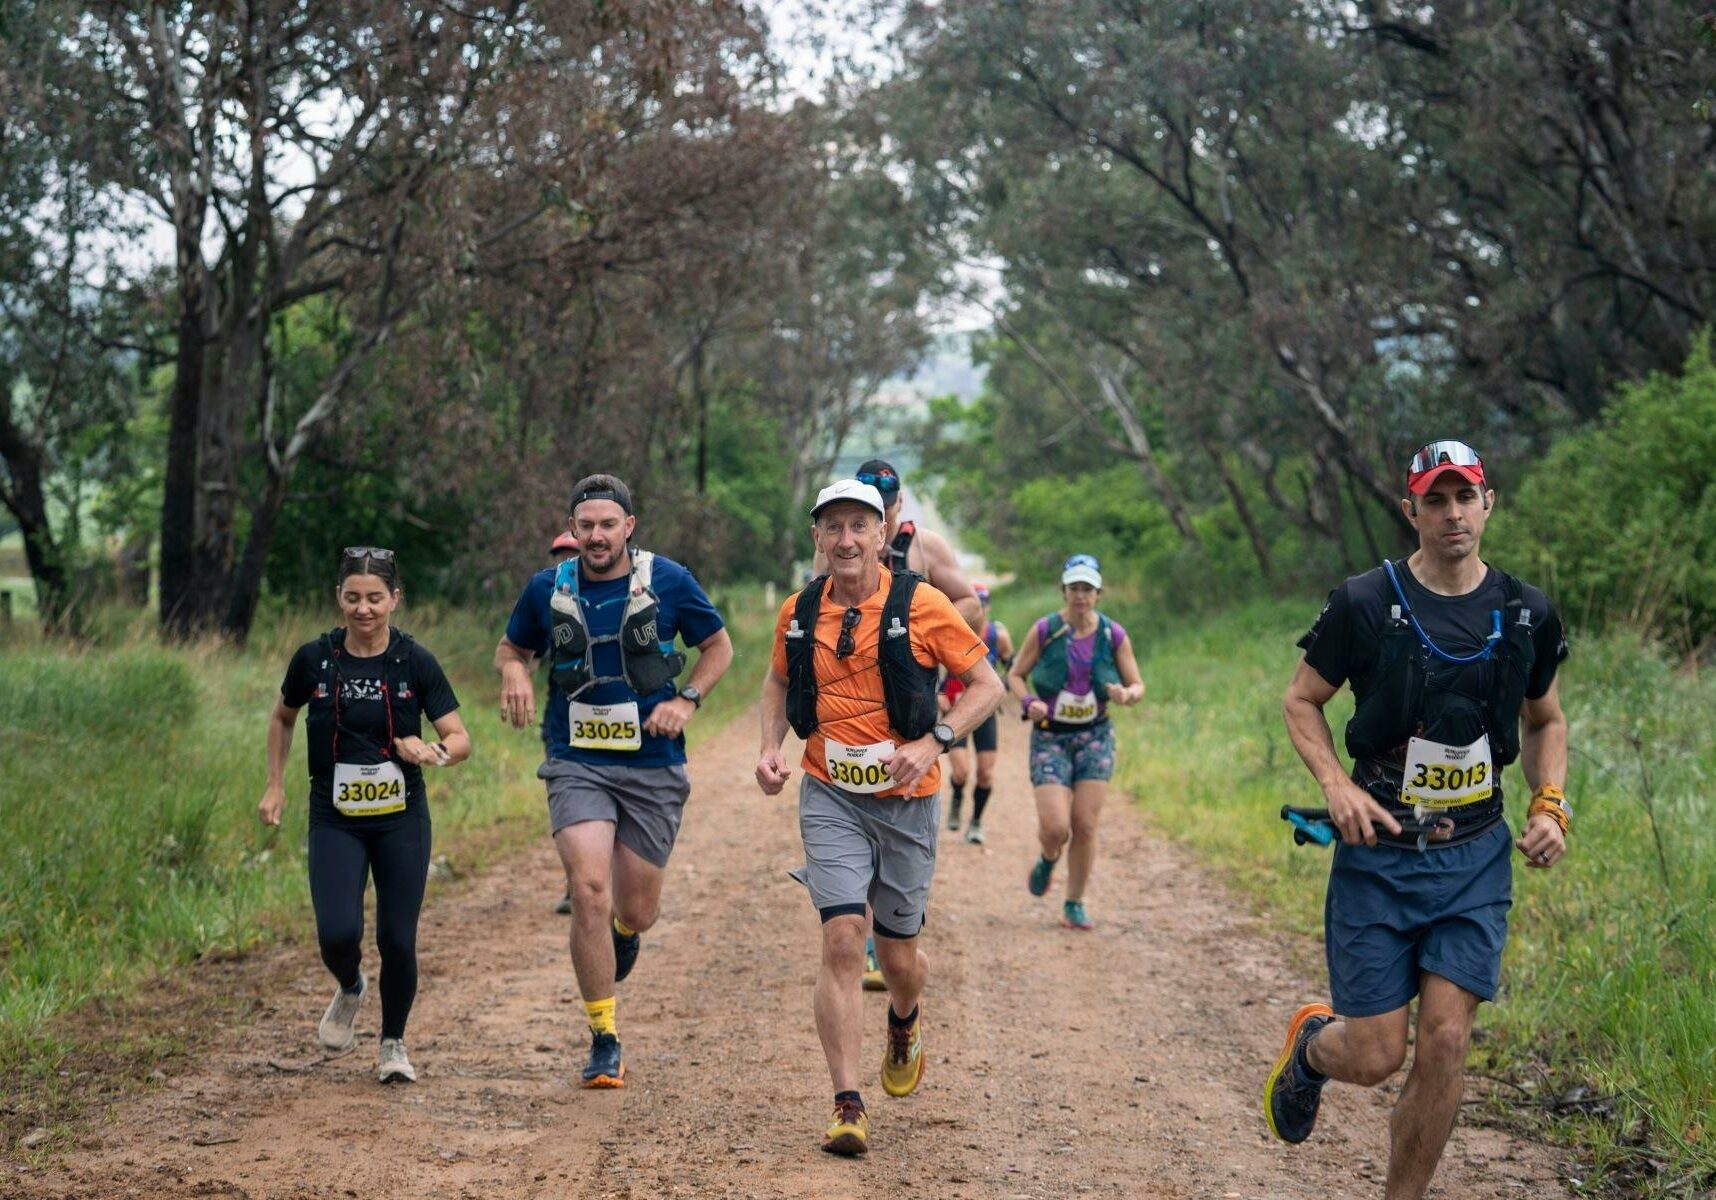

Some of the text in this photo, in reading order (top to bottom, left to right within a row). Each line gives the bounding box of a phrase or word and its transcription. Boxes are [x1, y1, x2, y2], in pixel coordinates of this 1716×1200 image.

[574, 720, 636, 740] 33025
[1412, 761, 1486, 790] 33013
[338, 779, 400, 802] 33024
